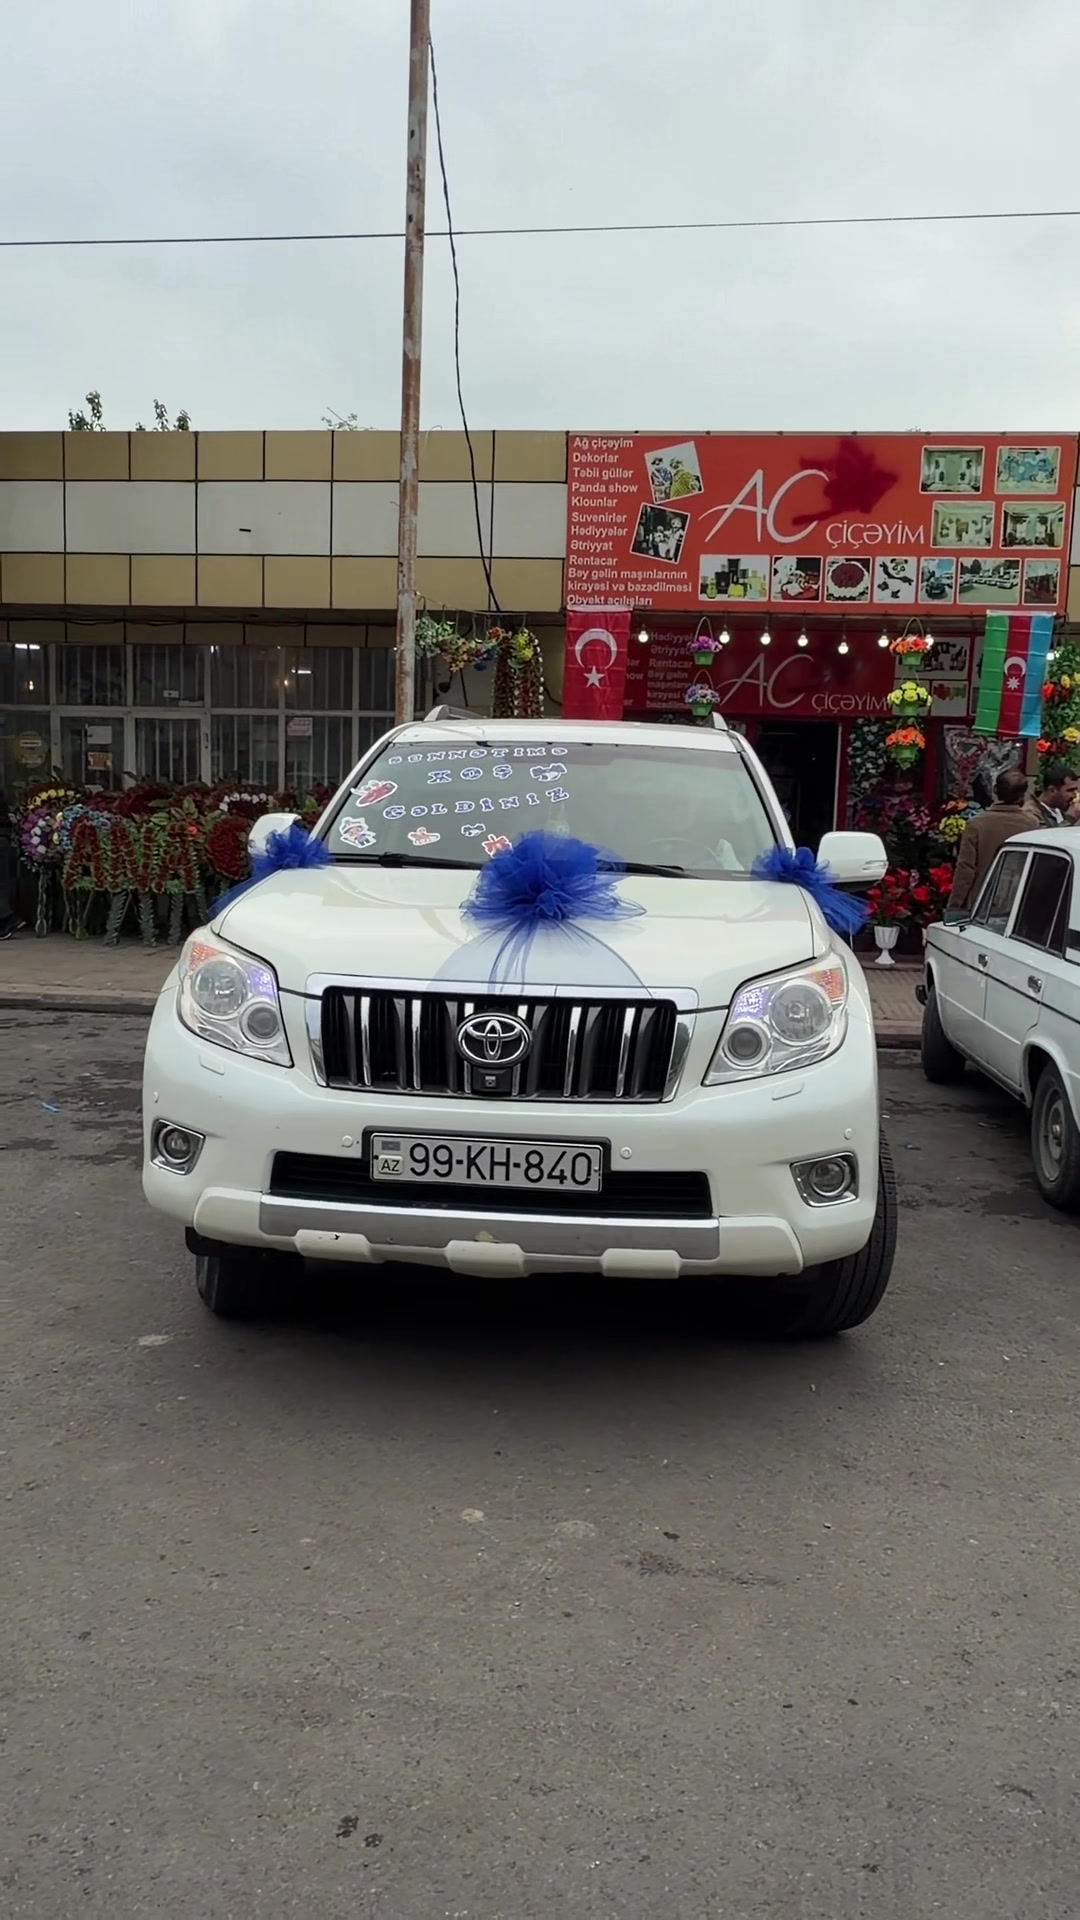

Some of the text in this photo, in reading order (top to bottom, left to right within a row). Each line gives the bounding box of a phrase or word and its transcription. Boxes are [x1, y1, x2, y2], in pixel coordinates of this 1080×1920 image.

[572, 452, 618, 462] Dekorlar
[602, 468, 634, 480] güllər
[572, 482, 638, 493] Panda show
[572, 496, 618, 507] Klounlar
[826, 520, 924, 550] ÇİÇƏYİM
[570, 540, 612, 552] Ətriyyat
[570, 556, 618, 566] Rentacar
[612, 584, 624, 592] və
[380, 1142, 593, 1186] AZ 99-KH-840
